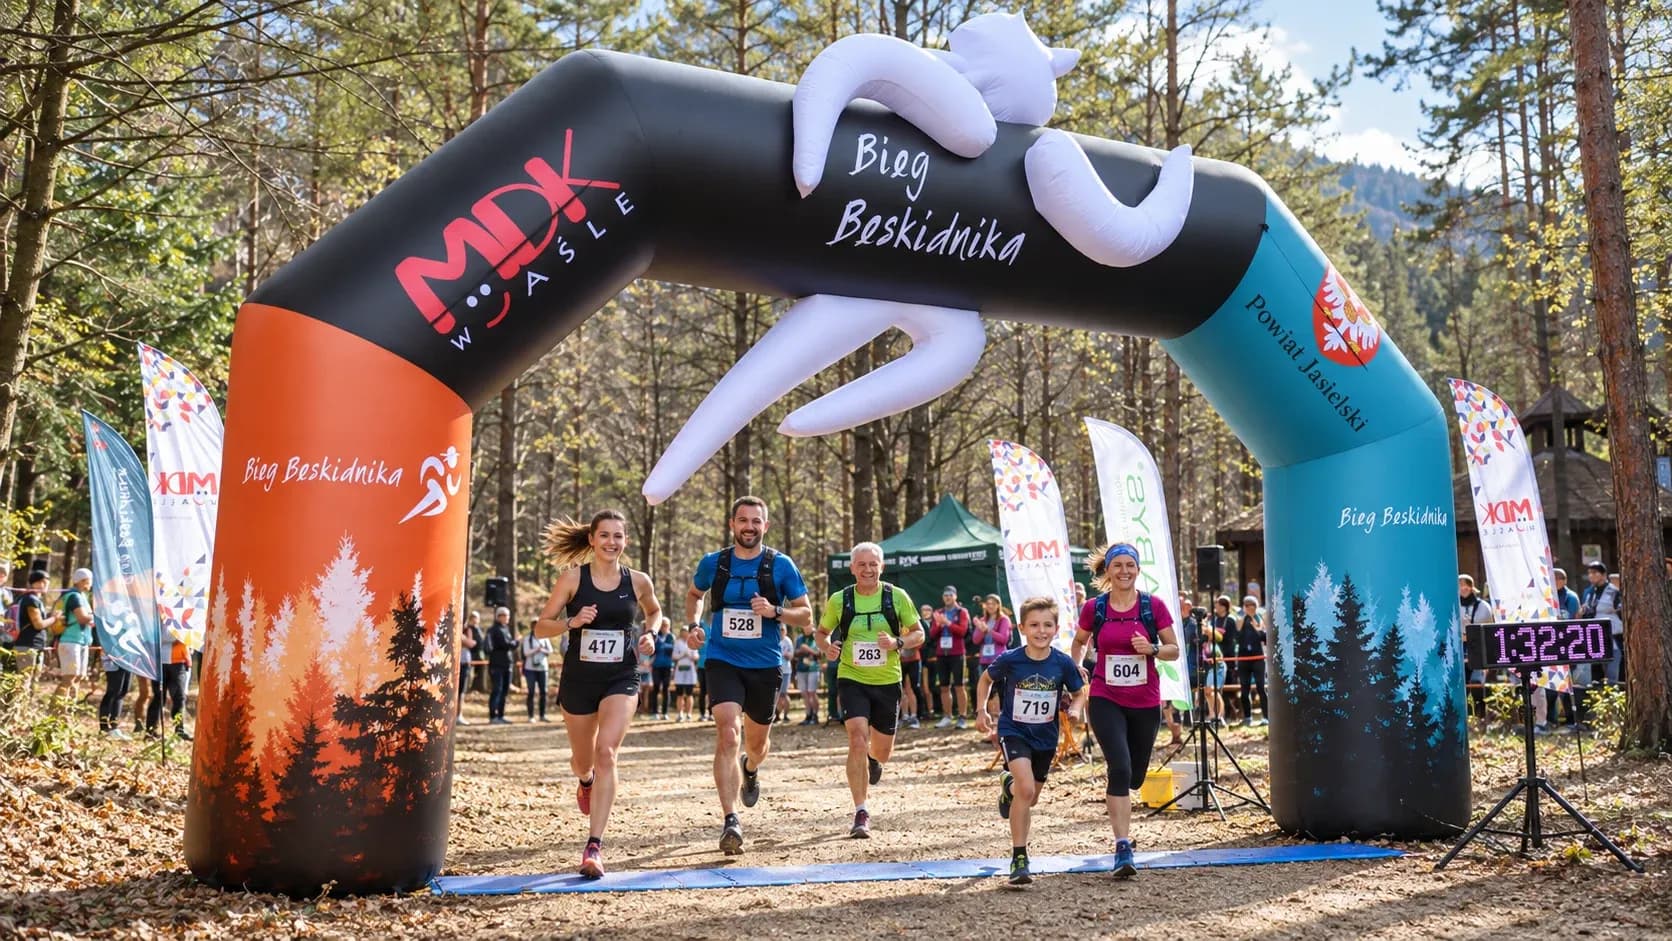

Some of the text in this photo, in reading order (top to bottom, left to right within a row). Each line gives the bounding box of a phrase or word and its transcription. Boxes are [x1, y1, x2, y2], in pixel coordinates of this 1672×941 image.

[849, 133, 930, 201] Bieg
[395, 128, 620, 334] MDK
[825, 198, 1026, 266] Beskidnika
[1244, 293, 1369, 433] Powiat Jasielski
[241, 455, 404, 492] Bieg Beskidnika
[1337, 505, 1448, 534] Bieg Beskidnika
[729, 617, 754, 631] 528
[588, 639, 617, 654] 417
[858, 648, 881, 661] 263
[1494, 623, 1605, 664] 1:32:20
[1113, 663, 1140, 678] 604
[1022, 699, 1050, 715] 719
